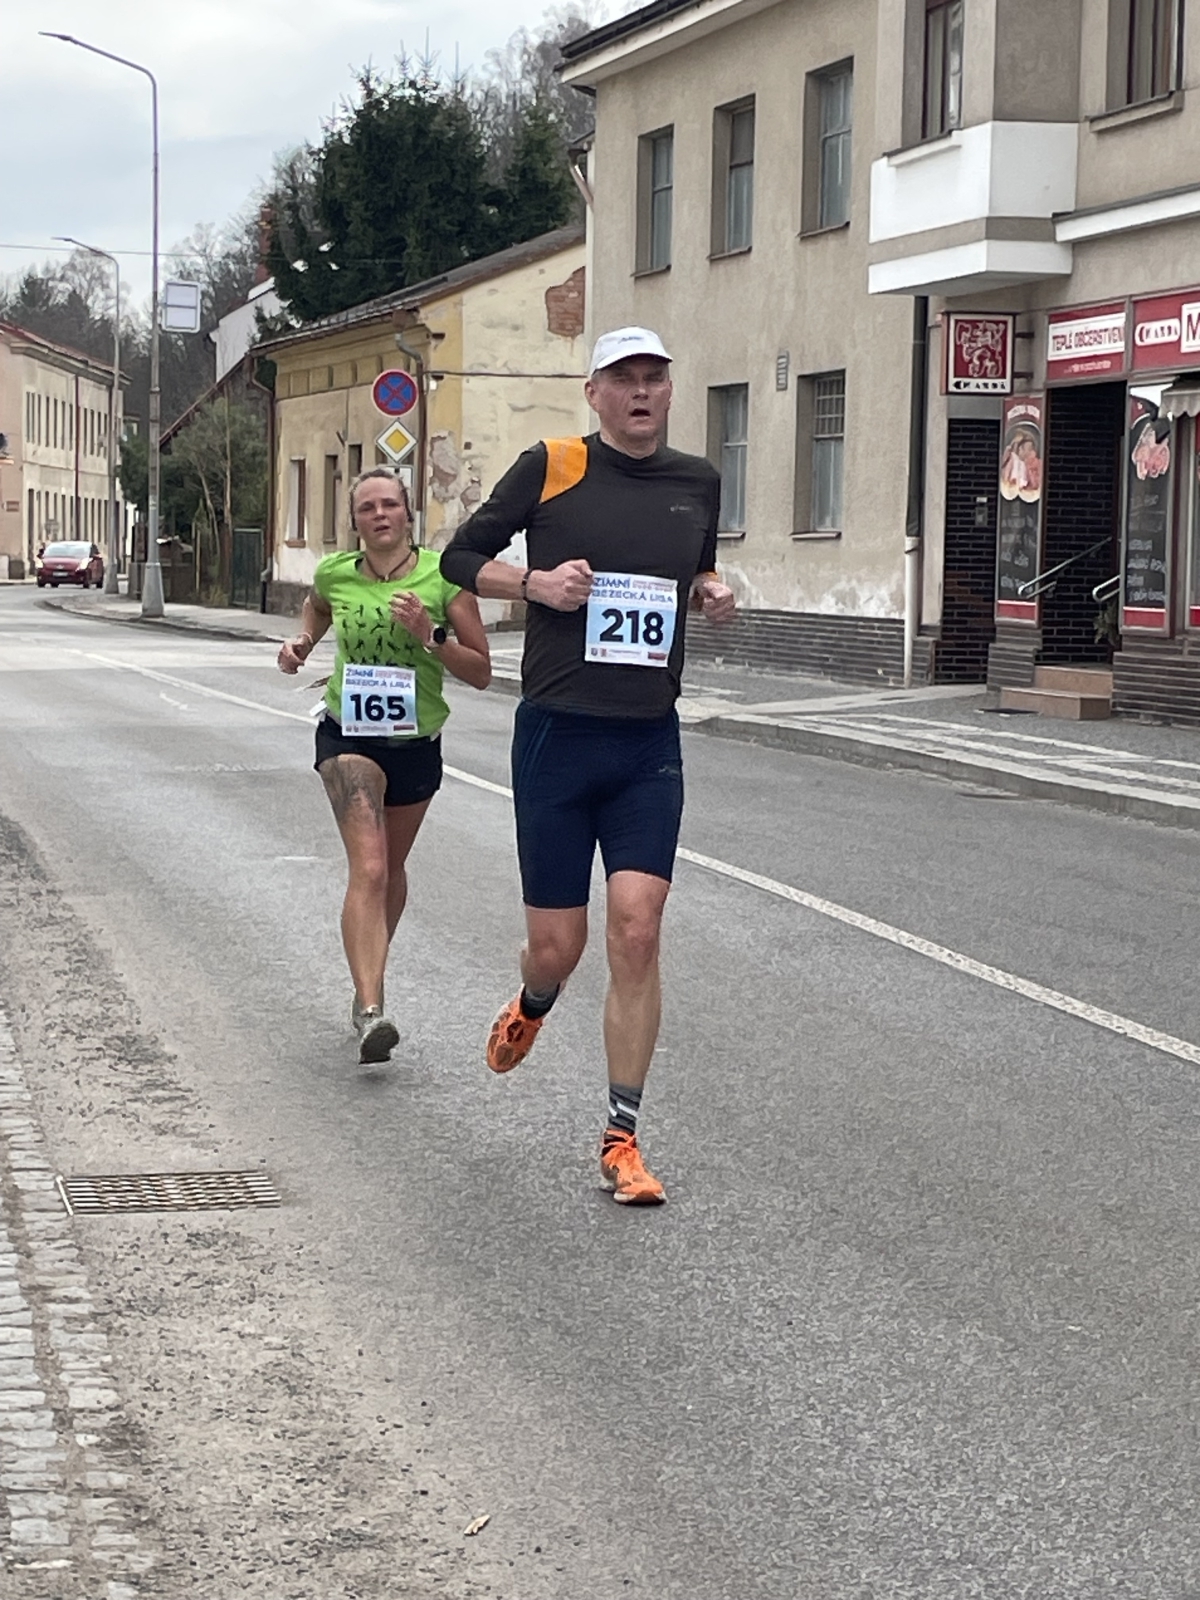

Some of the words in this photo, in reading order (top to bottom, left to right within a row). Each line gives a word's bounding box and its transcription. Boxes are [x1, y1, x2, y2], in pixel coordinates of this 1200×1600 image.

[1074, 325, 1124, 348] OBČERSTVEN
[599, 608, 664, 646] 218
[349, 693, 406, 721] 165
